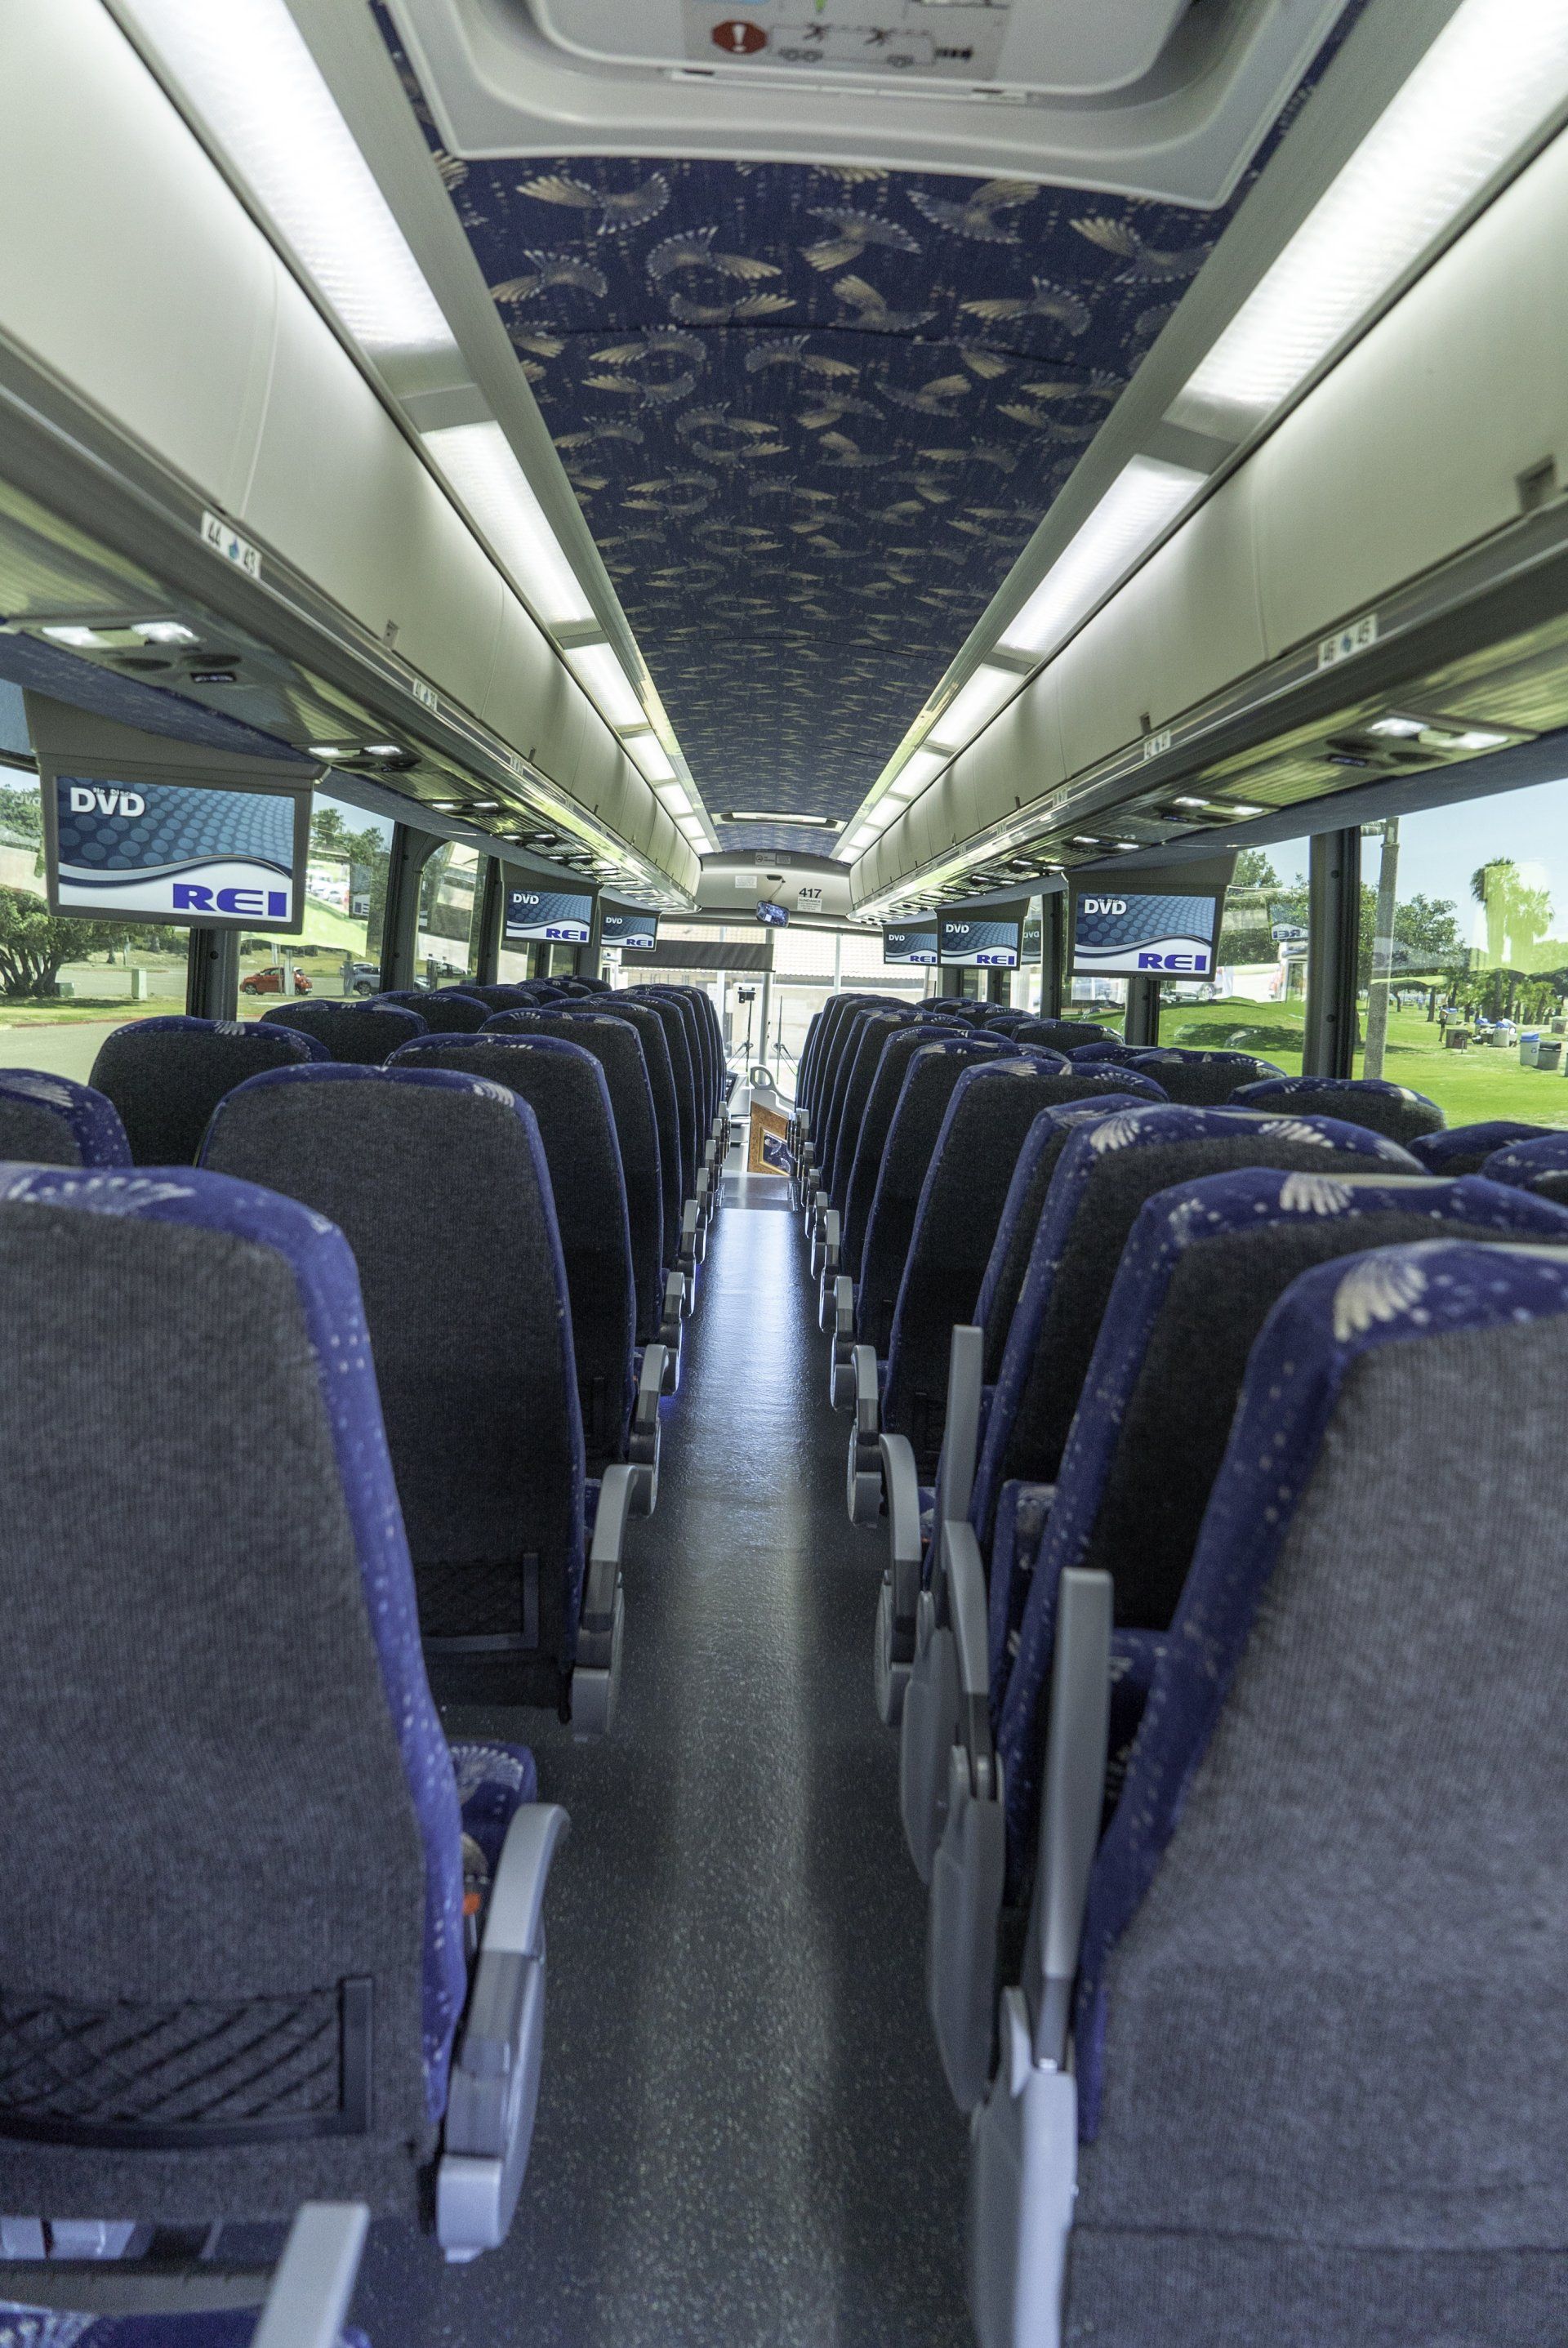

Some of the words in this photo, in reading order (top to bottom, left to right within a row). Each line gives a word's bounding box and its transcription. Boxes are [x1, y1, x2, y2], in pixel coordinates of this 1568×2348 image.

[70, 787, 145, 818] DVD
[799, 888, 822, 898] 417
[173, 883, 287, 917] REI
[513, 893, 539, 905] DVD
[1084, 899, 1127, 915] DVD
[605, 916, 623, 924] DVD
[946, 924, 969, 933] DVD
[546, 928, 587, 941] REI
[626, 938, 653, 947] REI
[910, 955, 937, 963] REI
[976, 955, 1015, 965] REI
[1138, 952, 1207, 971] REI
